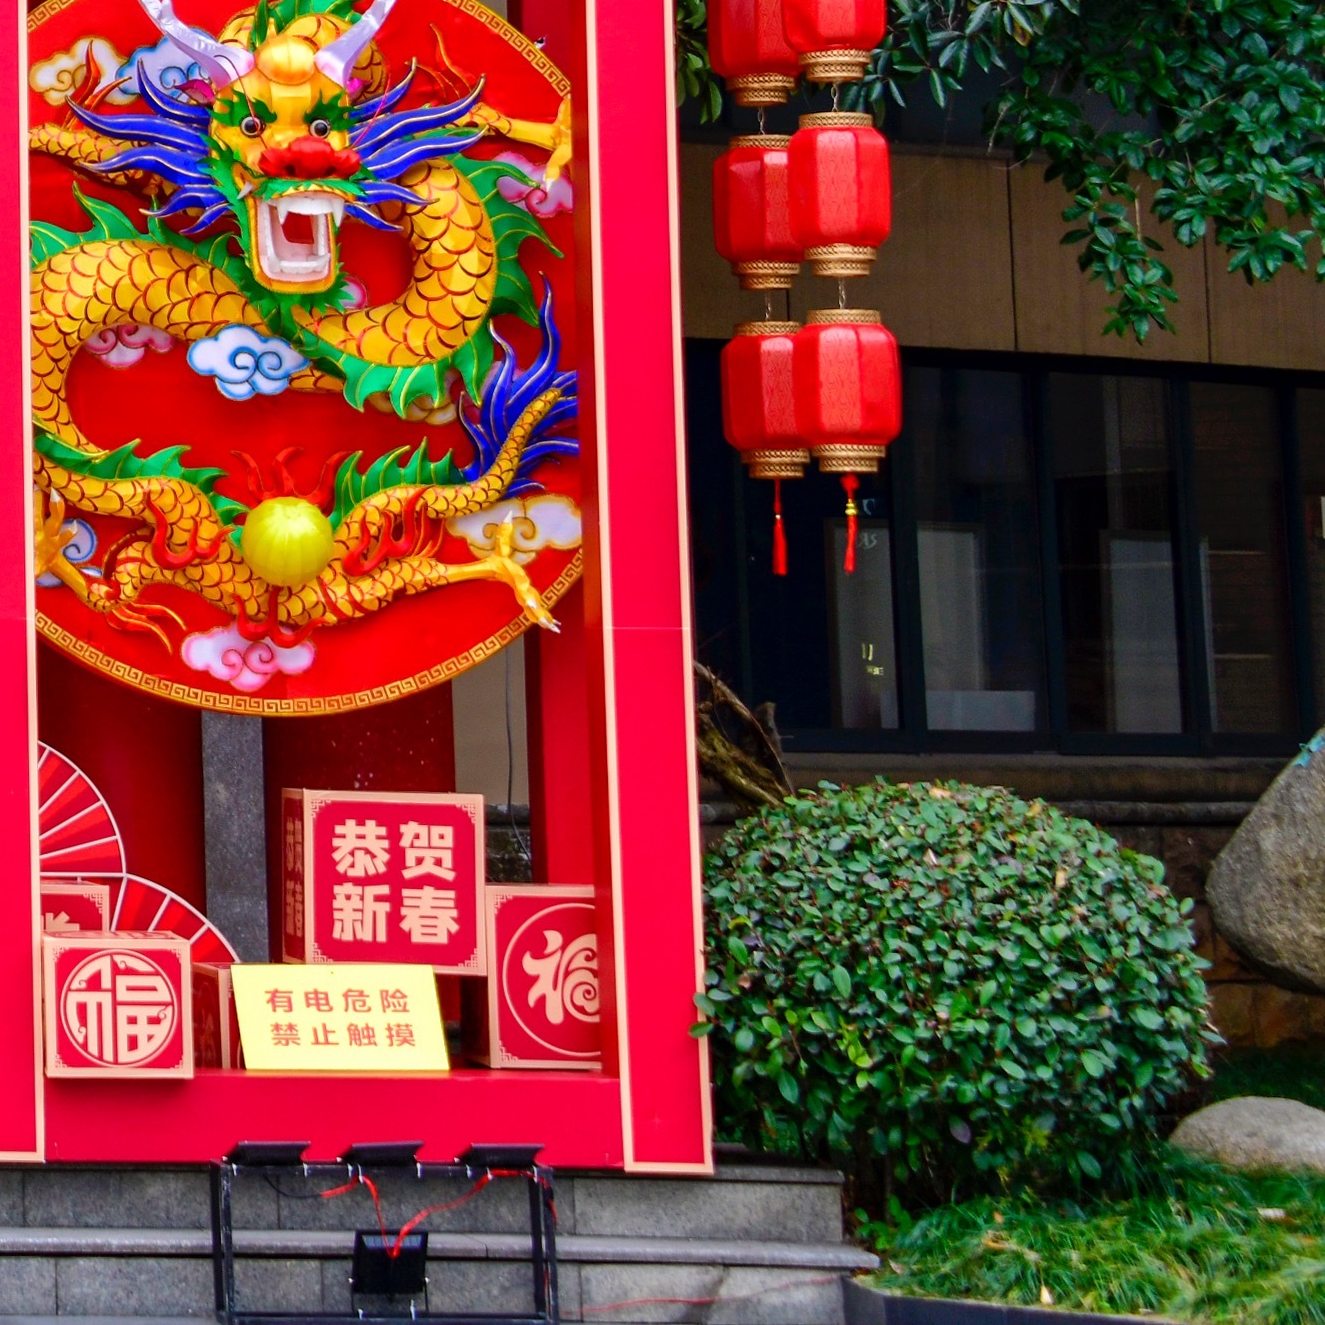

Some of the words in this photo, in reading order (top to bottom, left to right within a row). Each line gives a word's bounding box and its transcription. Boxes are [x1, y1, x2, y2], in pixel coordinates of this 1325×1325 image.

[330, 818, 457, 882] 恭贺
[330, 882, 460, 945] 新春
[64, 954, 175, 1064] 福
[264, 986, 411, 1015] 有电危险
[270, 1021, 417, 1049] 禁止触摸
